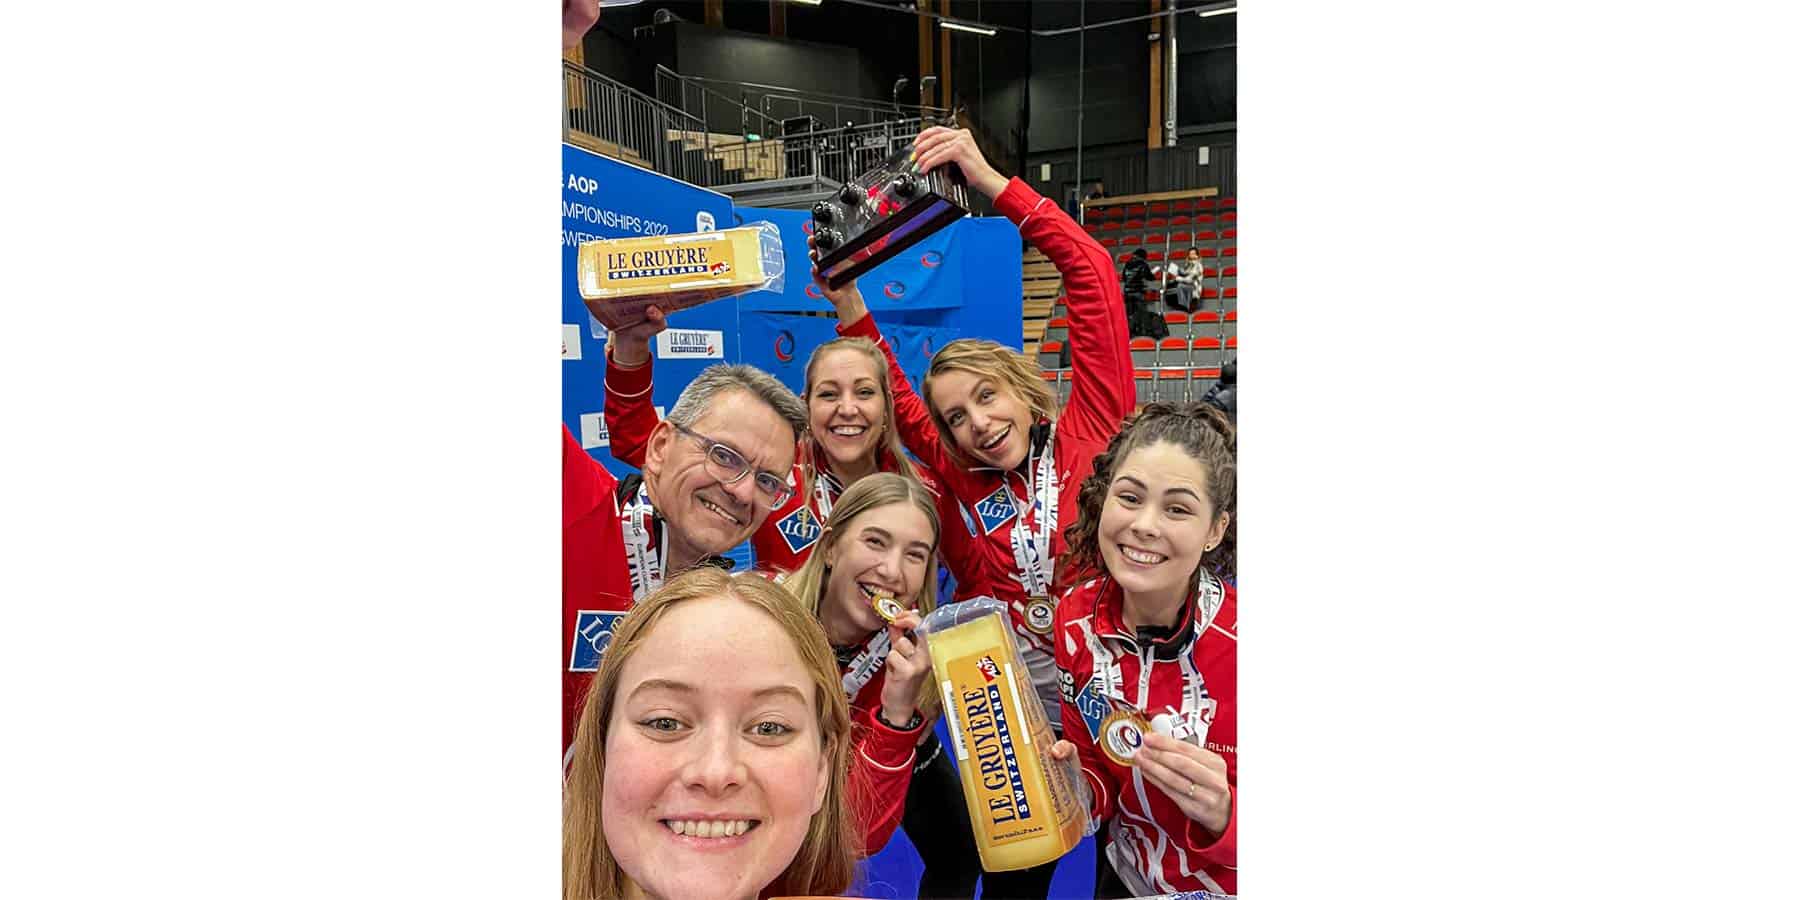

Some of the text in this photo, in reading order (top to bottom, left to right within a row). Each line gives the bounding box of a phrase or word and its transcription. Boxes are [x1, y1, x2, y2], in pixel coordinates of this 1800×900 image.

[568, 174, 598, 195] AOP
[562, 200, 669, 236] MPIONSHIPS 2022
[608, 246, 708, 270] LE GRUYÈRE
[611, 266, 706, 279] SWITZERLAND
[982, 501, 1012, 519] LGT
[784, 519, 820, 540] LGT
[579, 615, 614, 654] LG
[962, 687, 1017, 825] LE GRUYÈRE
[988, 688, 1029, 815] SWITZERLAND
[1204, 742, 1238, 753] RLIN
